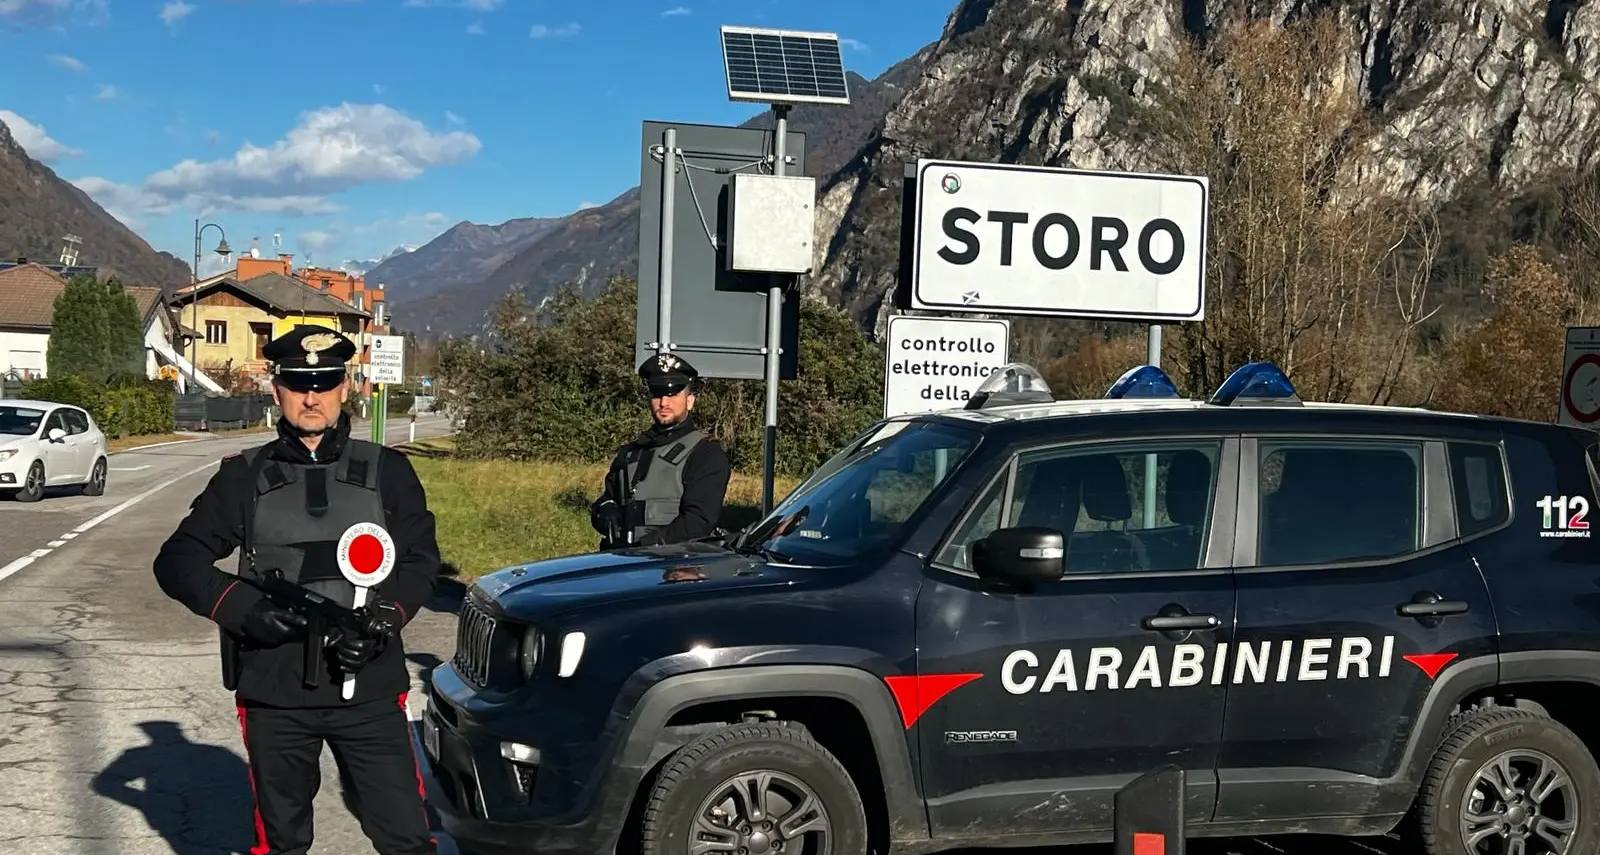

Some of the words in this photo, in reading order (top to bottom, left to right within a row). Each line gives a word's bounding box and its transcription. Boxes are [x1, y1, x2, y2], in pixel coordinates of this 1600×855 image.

[937, 207, 1185, 275] STORO
[901, 337, 995, 353] controllo
[920, 385, 970, 401] della
[1536, 495, 1590, 529] 112
[1001, 635, 1394, 694] CARABINIERI
[945, 731, 1017, 743] RENEGADE
